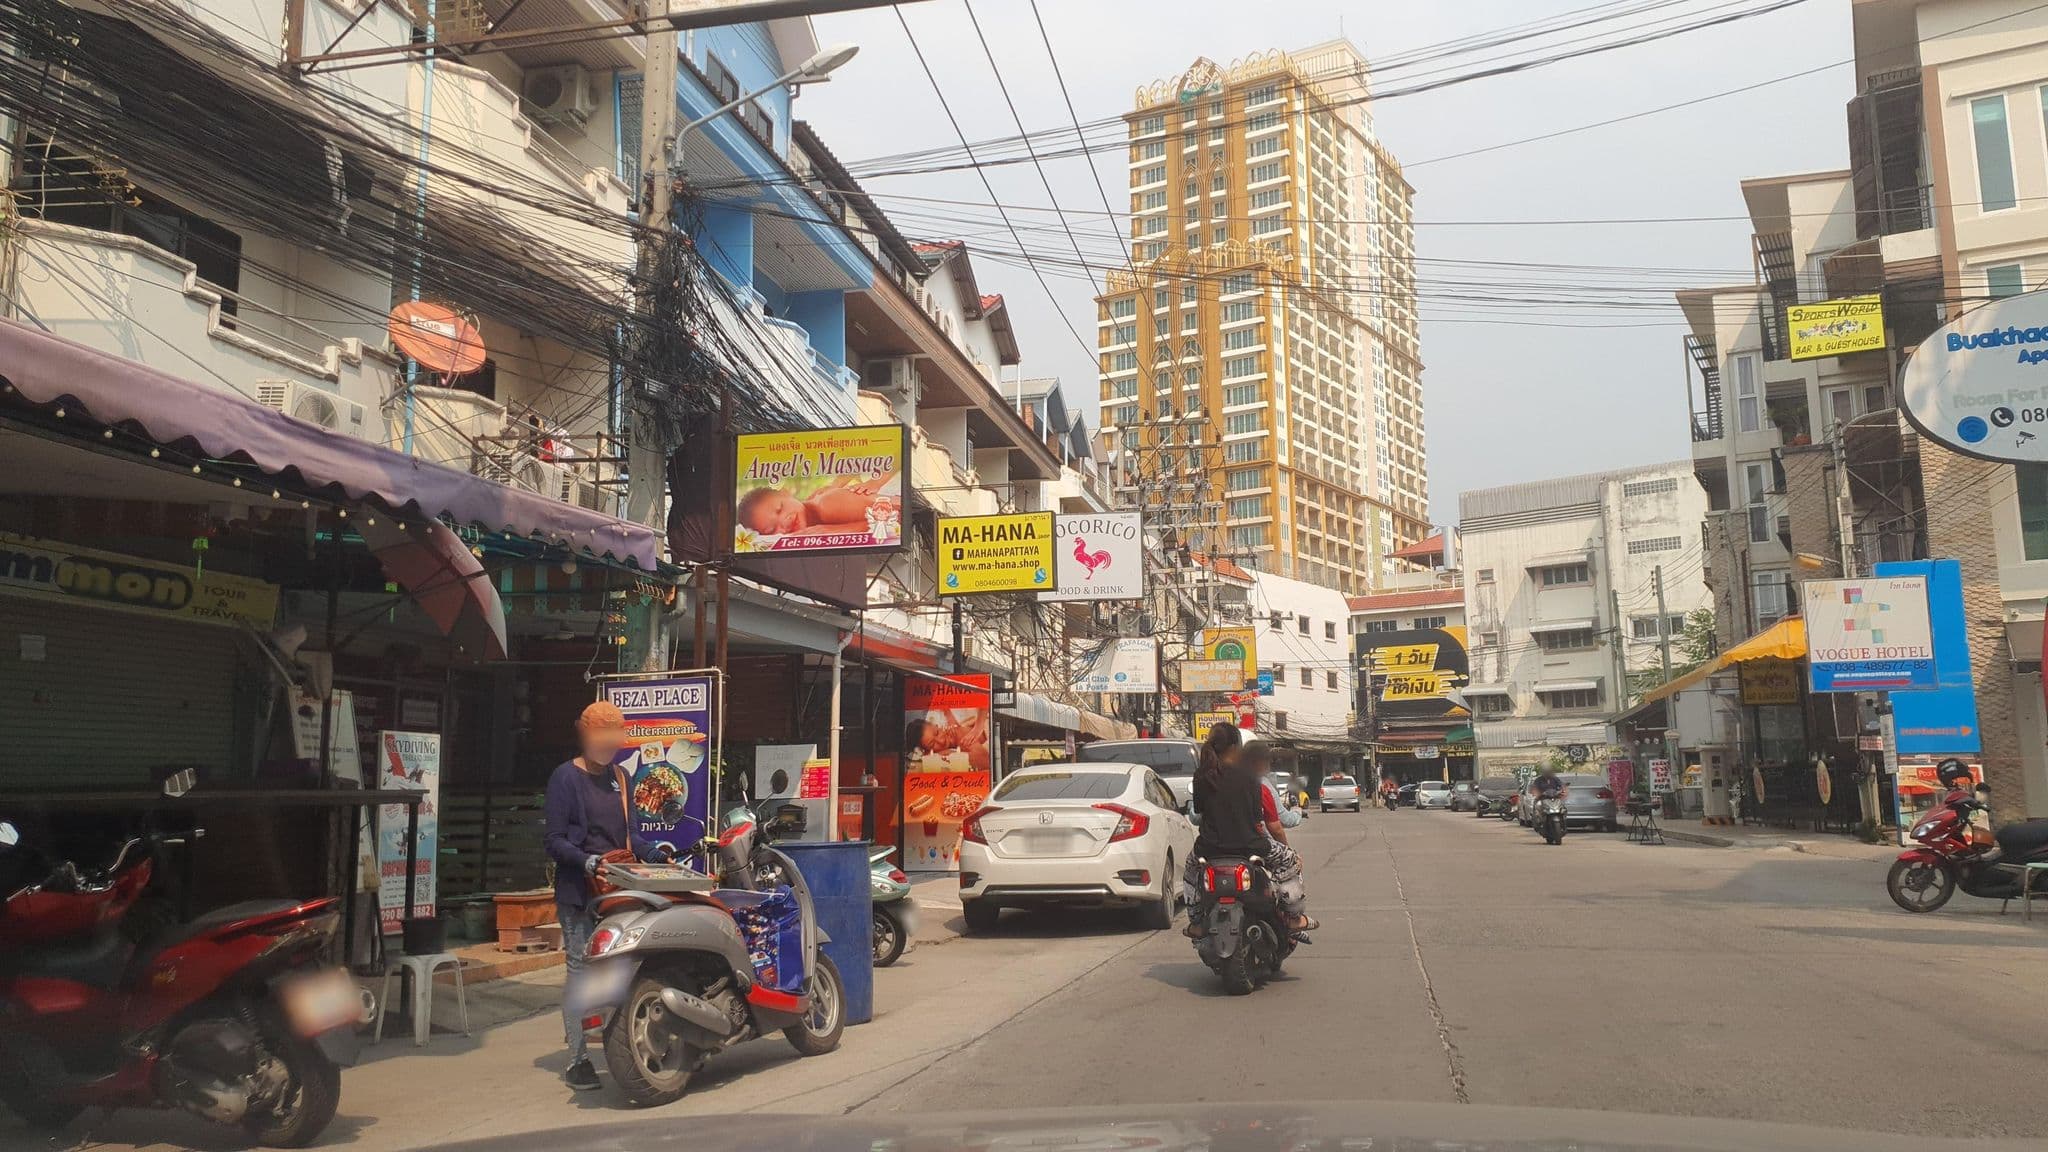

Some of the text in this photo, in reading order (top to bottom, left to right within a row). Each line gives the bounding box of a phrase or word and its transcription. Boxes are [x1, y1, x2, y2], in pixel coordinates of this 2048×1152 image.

[1816, 343, 1823, 352] &
[2021, 407, 2048, 424] 08
[745, 452, 893, 484] Angel's Massage
[943, 523, 1036, 545] MA-HANA
[1056, 519, 1136, 540] OCORICO
[780, 535, 869, 547] Tel: 096-5027533
[967, 546, 1040, 558] MAHANAPATTAYA
[952, 559, 1040, 572] www.ma-hana.shop
[1083, 586, 1091, 594] &
[1093, 585, 1124, 595] DRINK
[192, 605, 249, 622] TRAVE
[1394, 649, 1430, 666] 1 วัน
[1815, 646, 1929, 661] VOGUE HOTEL
[612, 688, 700, 708] BEZA PLACE
[624, 725, 695, 738] editerranean
[909, 775, 984, 791] Food & Drink
